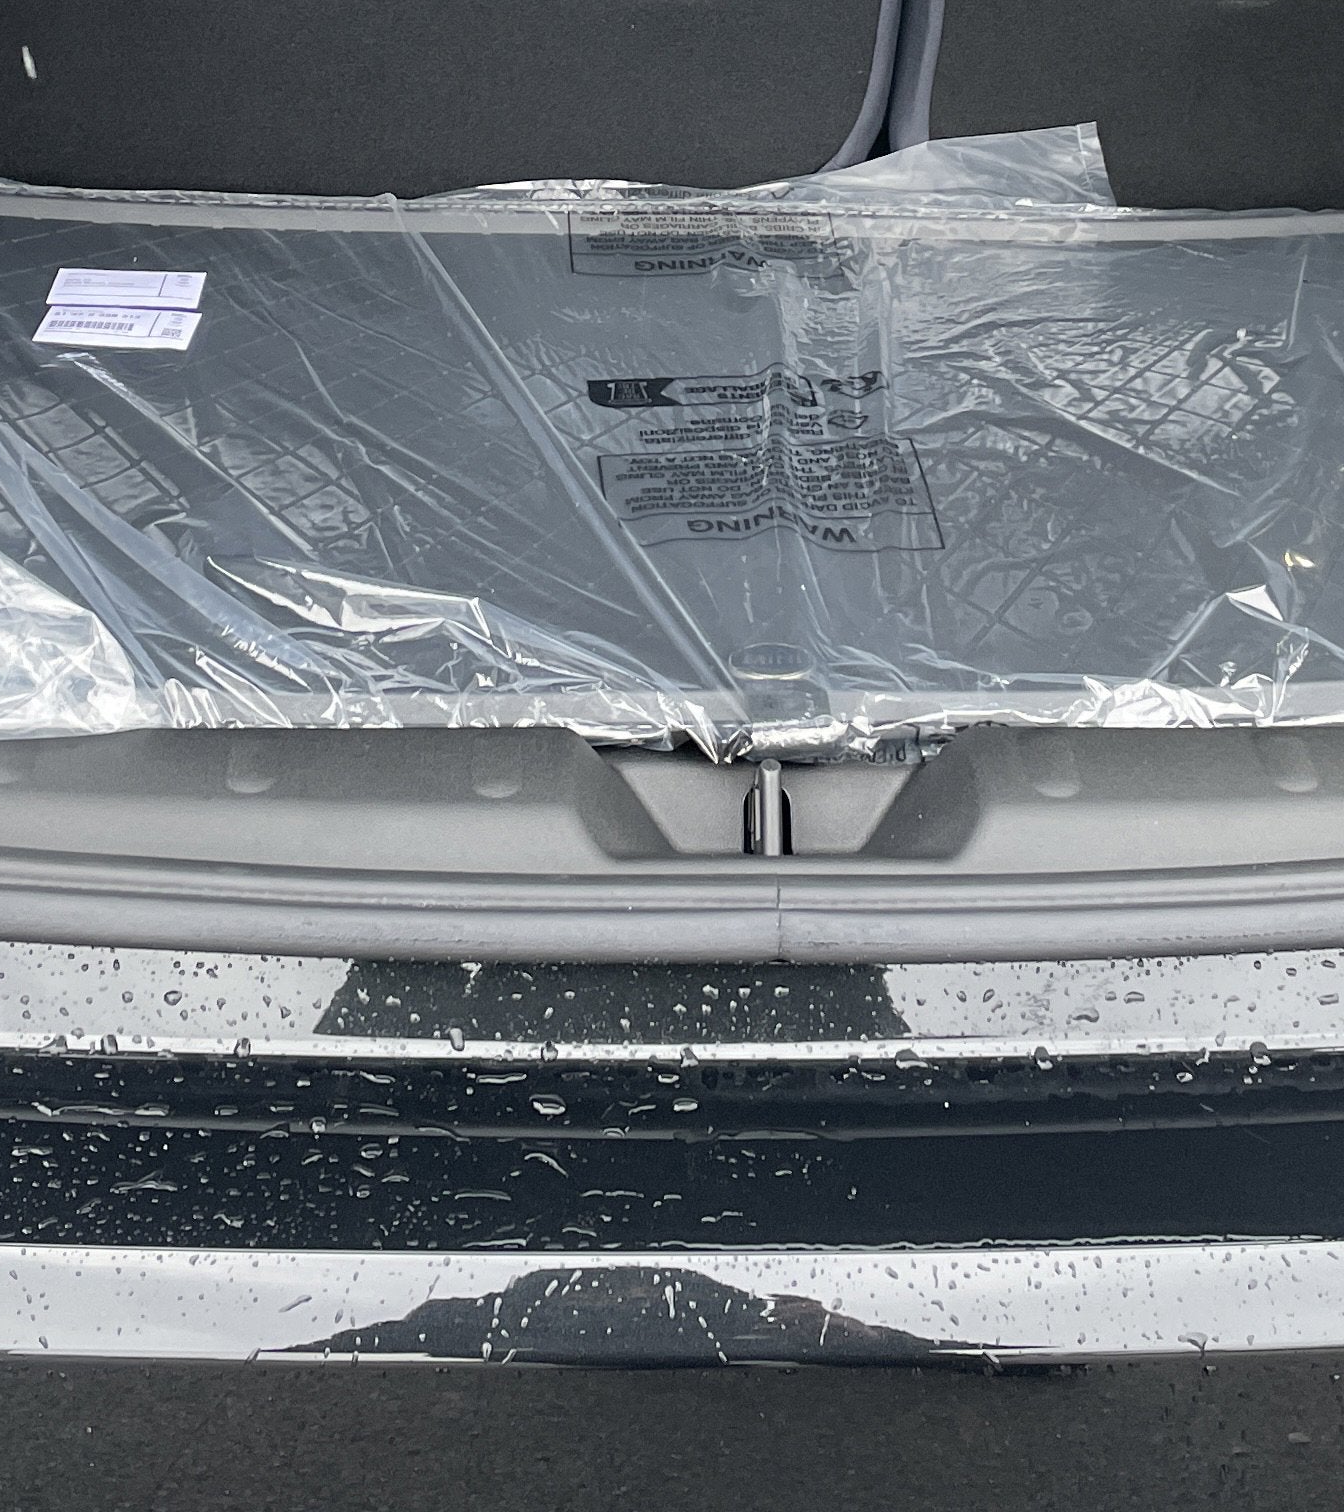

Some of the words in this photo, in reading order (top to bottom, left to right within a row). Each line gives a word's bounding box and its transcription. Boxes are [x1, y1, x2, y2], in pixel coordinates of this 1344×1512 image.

[671, 470, 706, 478] MAY
[710, 469, 747, 478] FILM
[717, 485, 741, 493] DO
[625, 495, 674, 506] FROM
[679, 493, 726, 501] AWAY
[632, 501, 747, 513] SUFFOCATION
[687, 507, 856, 543] WARNING
